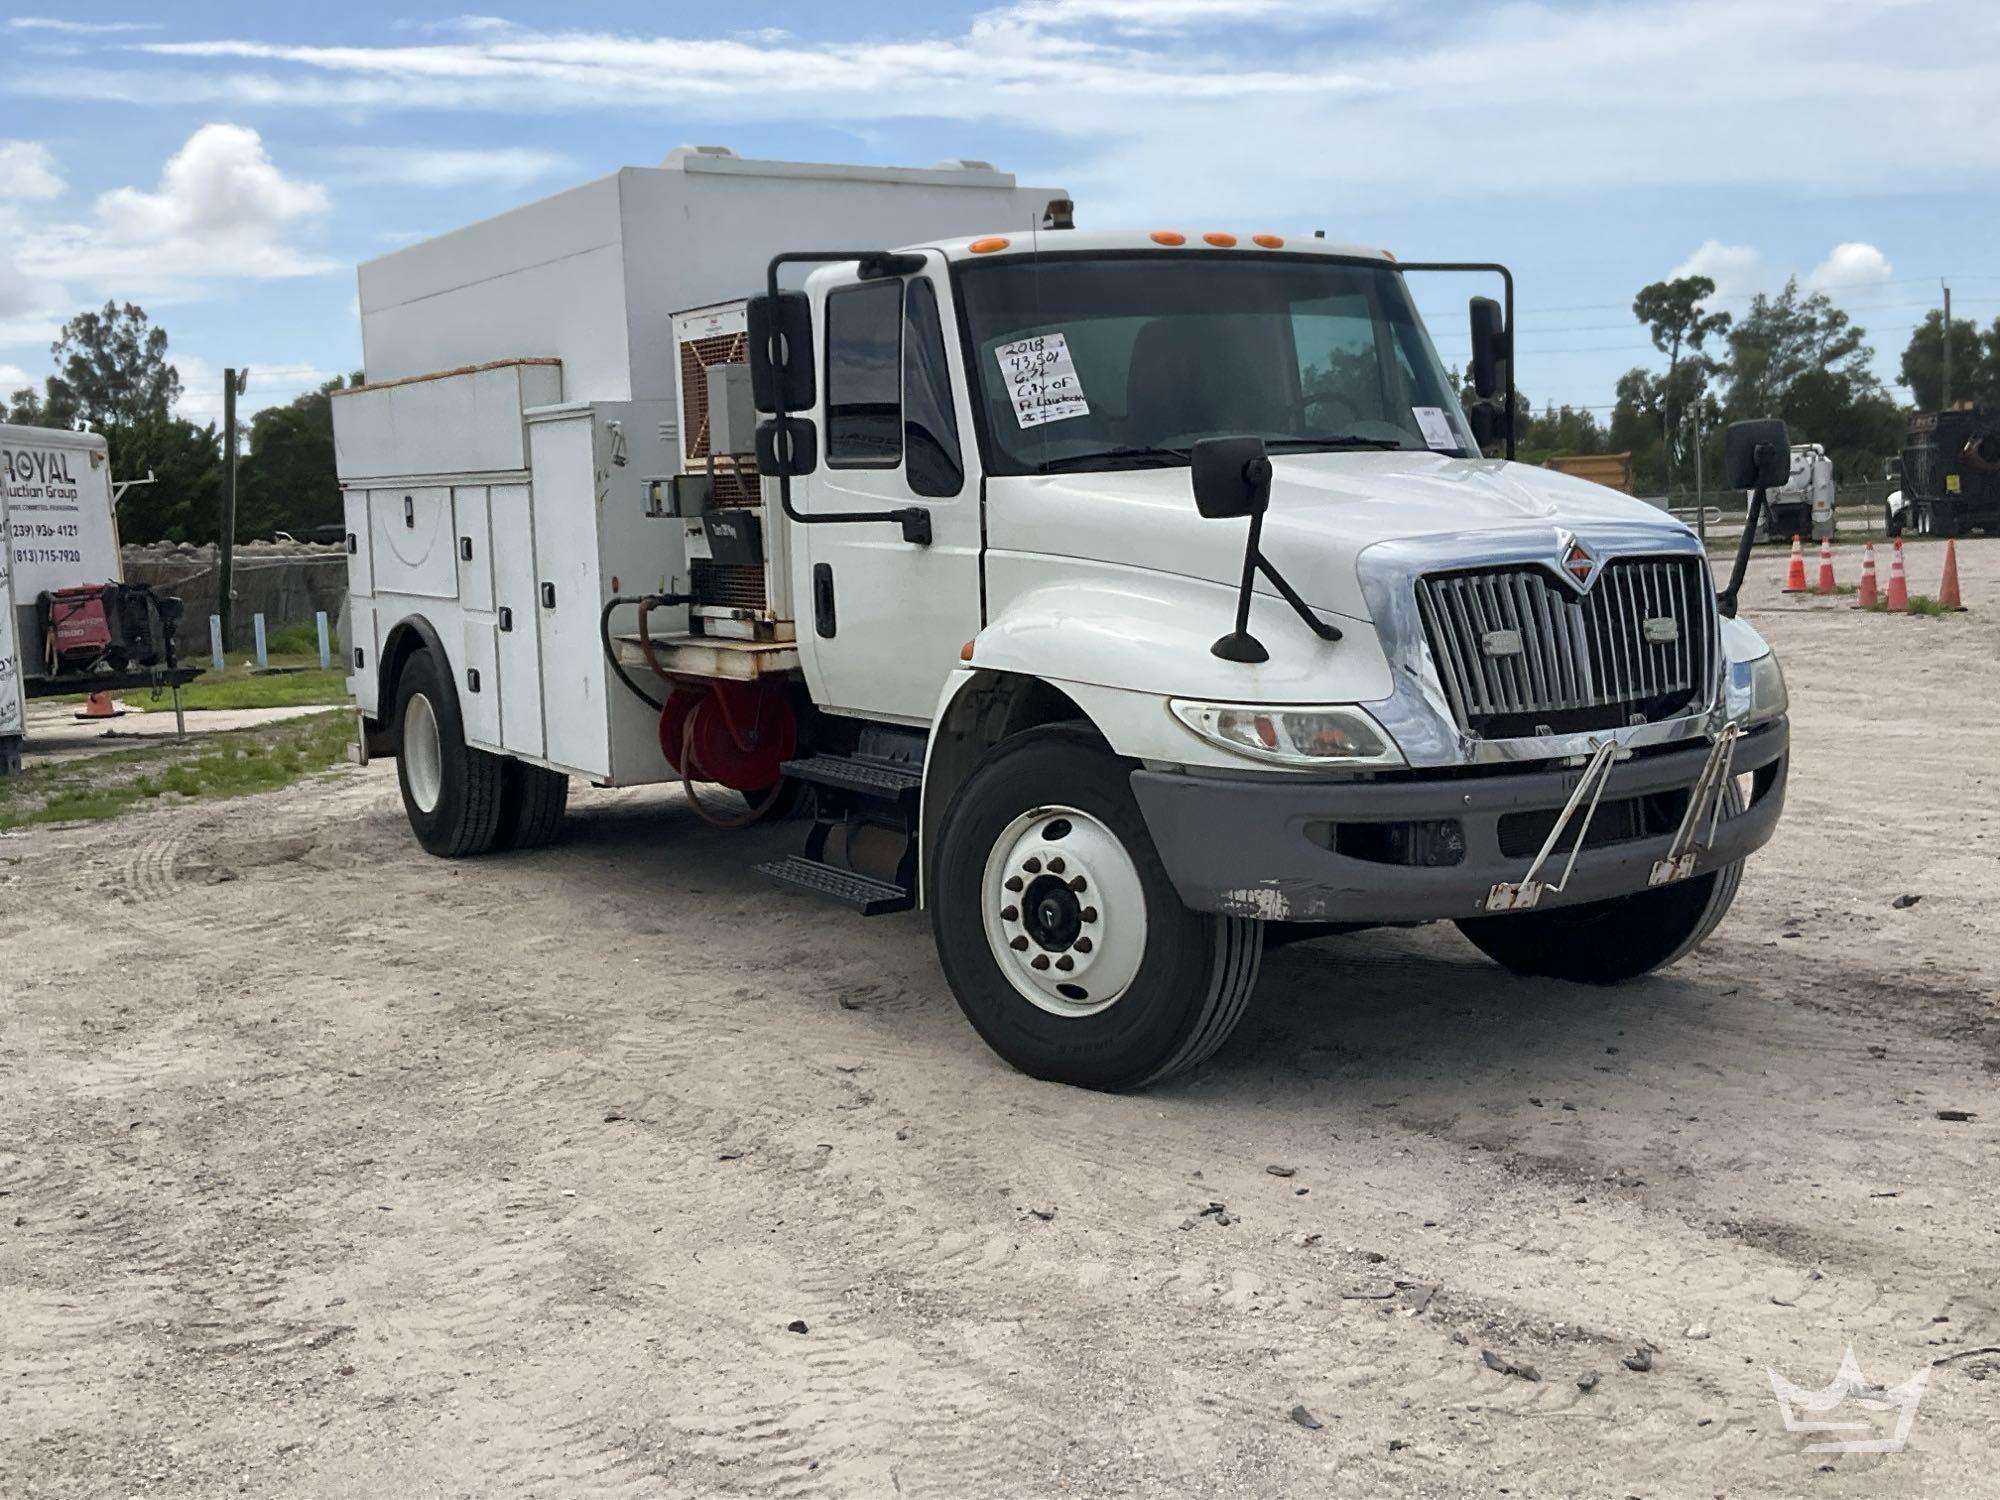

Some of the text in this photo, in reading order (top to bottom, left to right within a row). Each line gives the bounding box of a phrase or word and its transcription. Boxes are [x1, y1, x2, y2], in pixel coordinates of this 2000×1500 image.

[1006, 338, 1045, 355] 2018
[3, 450, 76, 484] ROYAL
[46, 485, 78, 502] Group
[10, 524, 35, 540] (239)
[13, 549, 81, 565] (813) 715-7920
